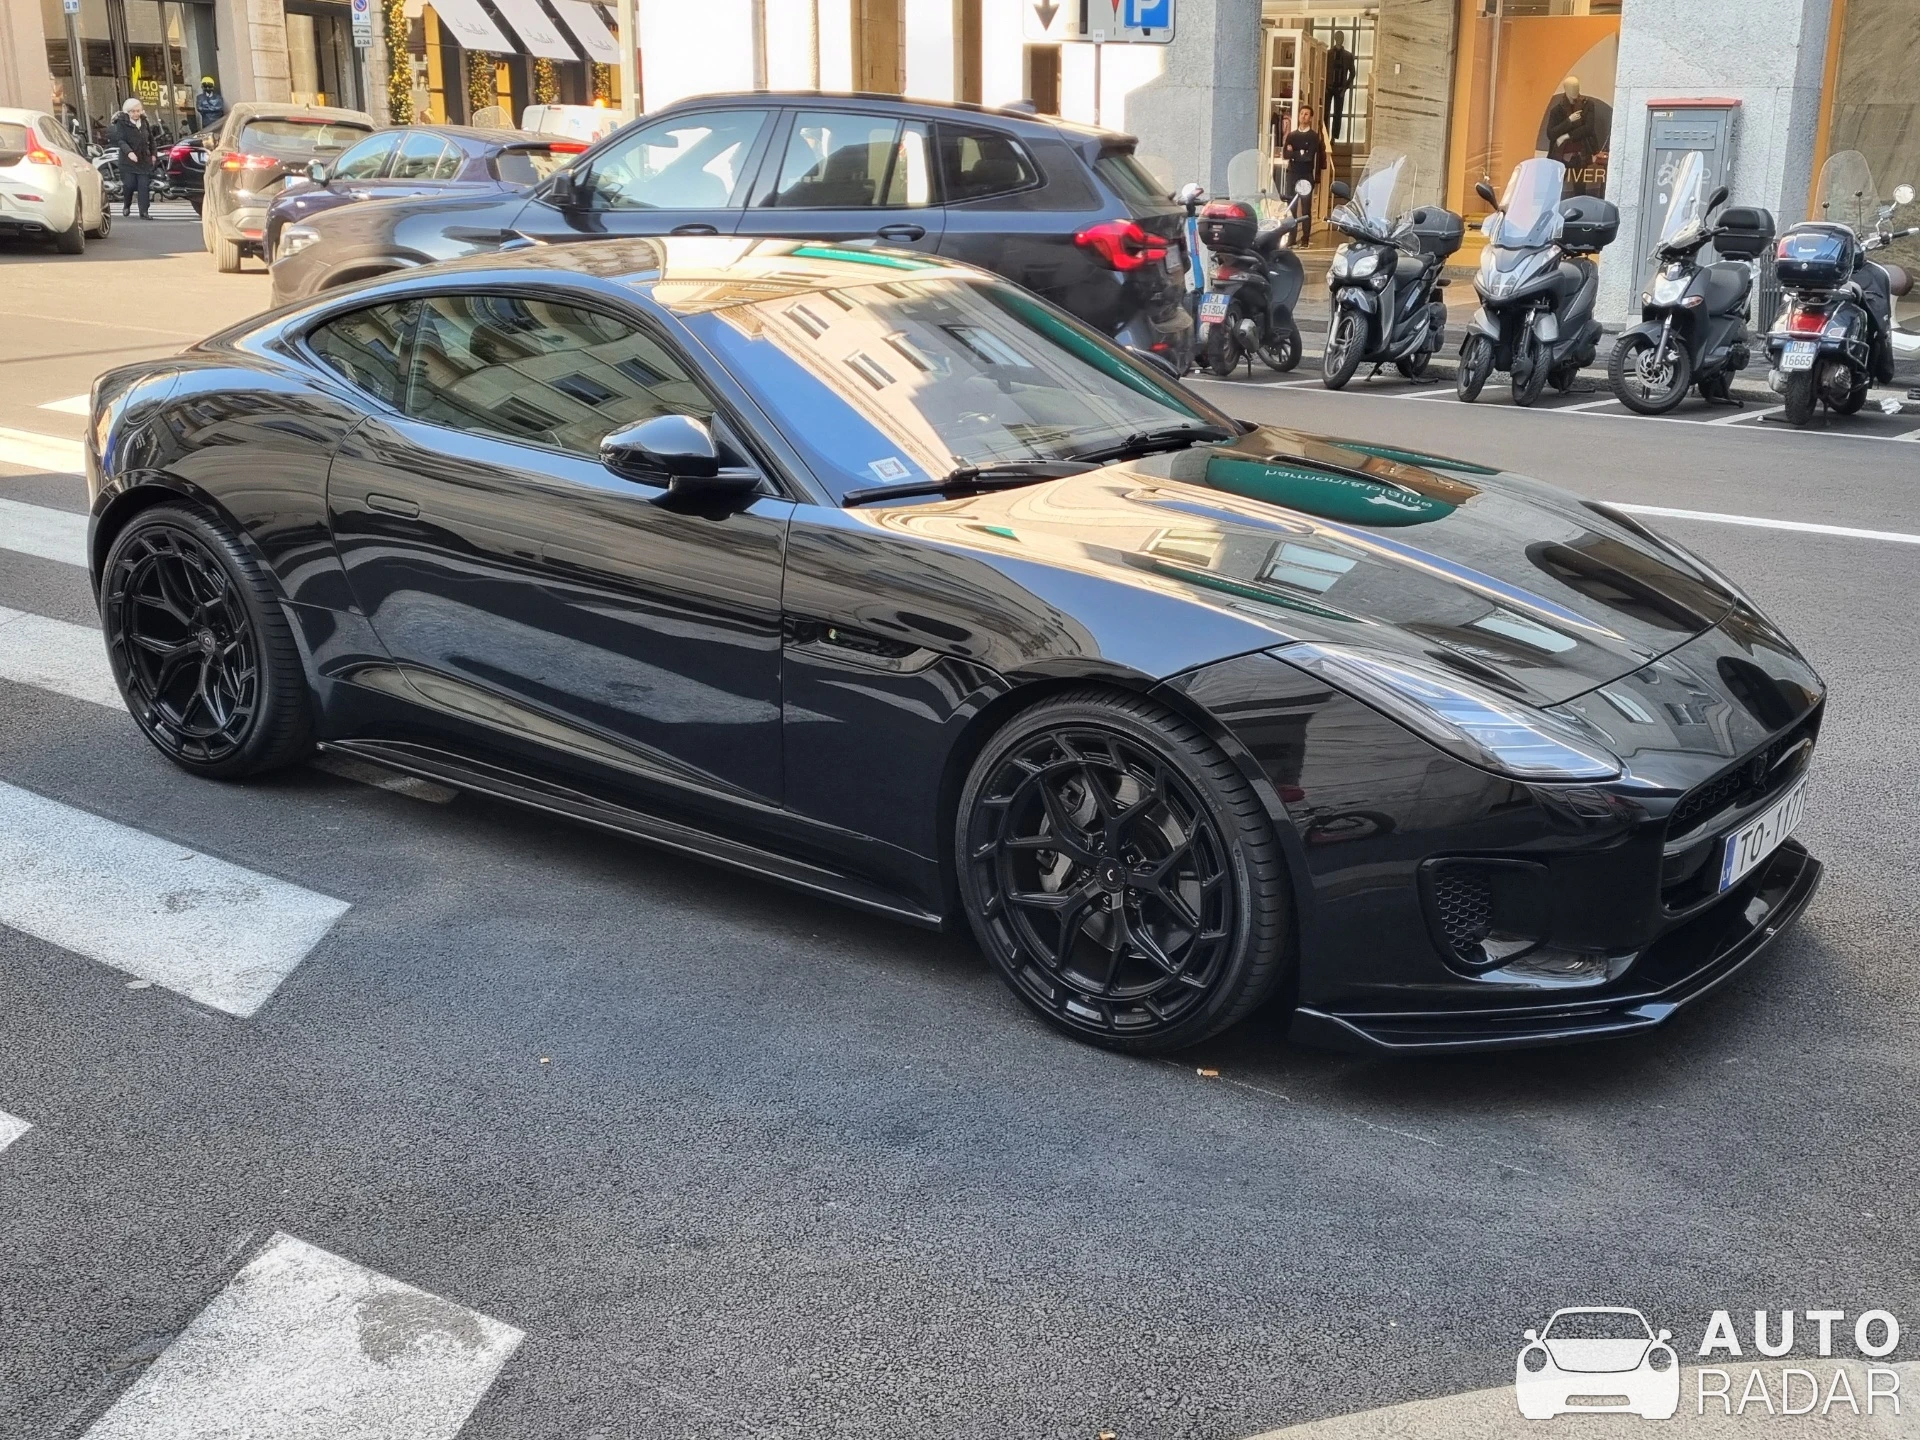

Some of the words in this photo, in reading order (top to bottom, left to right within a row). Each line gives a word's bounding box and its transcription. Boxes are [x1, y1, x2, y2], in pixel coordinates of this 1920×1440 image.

[1133, 0, 1161, 23] P
[1210, 294, 1219, 304] EA
[1784, 355, 1812, 366] 16665
